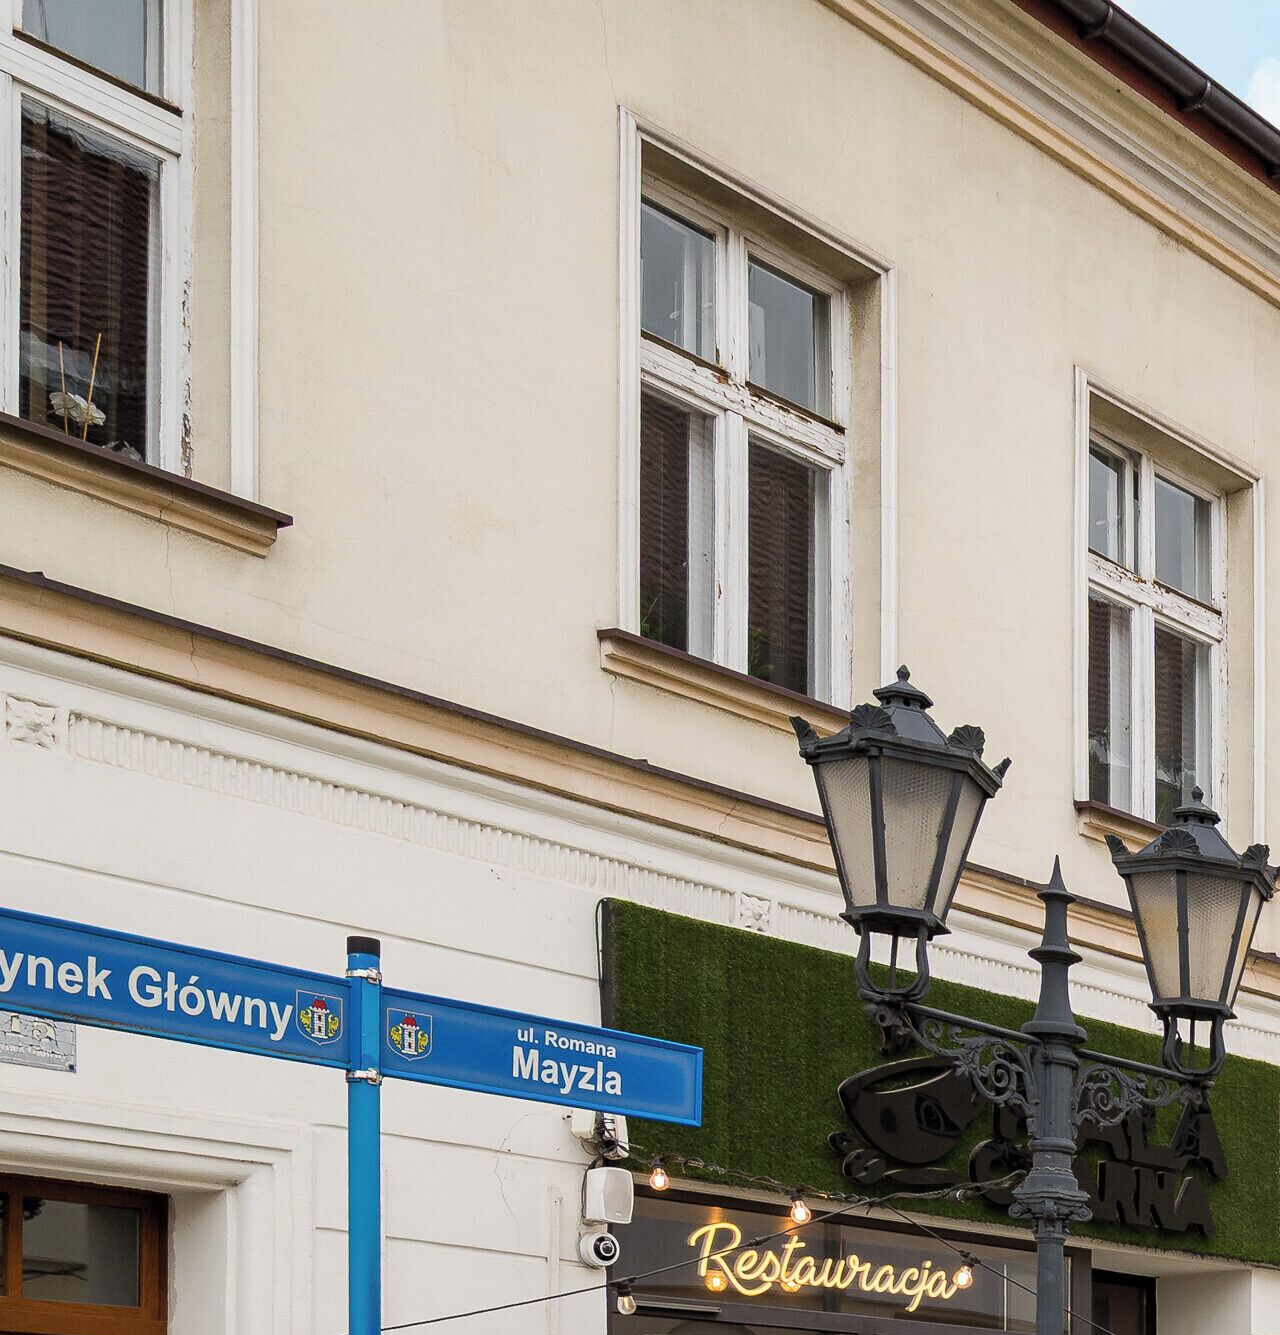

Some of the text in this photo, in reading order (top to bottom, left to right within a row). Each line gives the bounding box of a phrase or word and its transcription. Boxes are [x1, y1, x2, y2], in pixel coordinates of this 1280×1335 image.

[0, 950, 293, 1041] ynek Główny
[512, 1045, 622, 1096] Mayzla
[517, 1027, 616, 1059] ul. Romana
[687, 1221, 958, 1312] Restauracja
